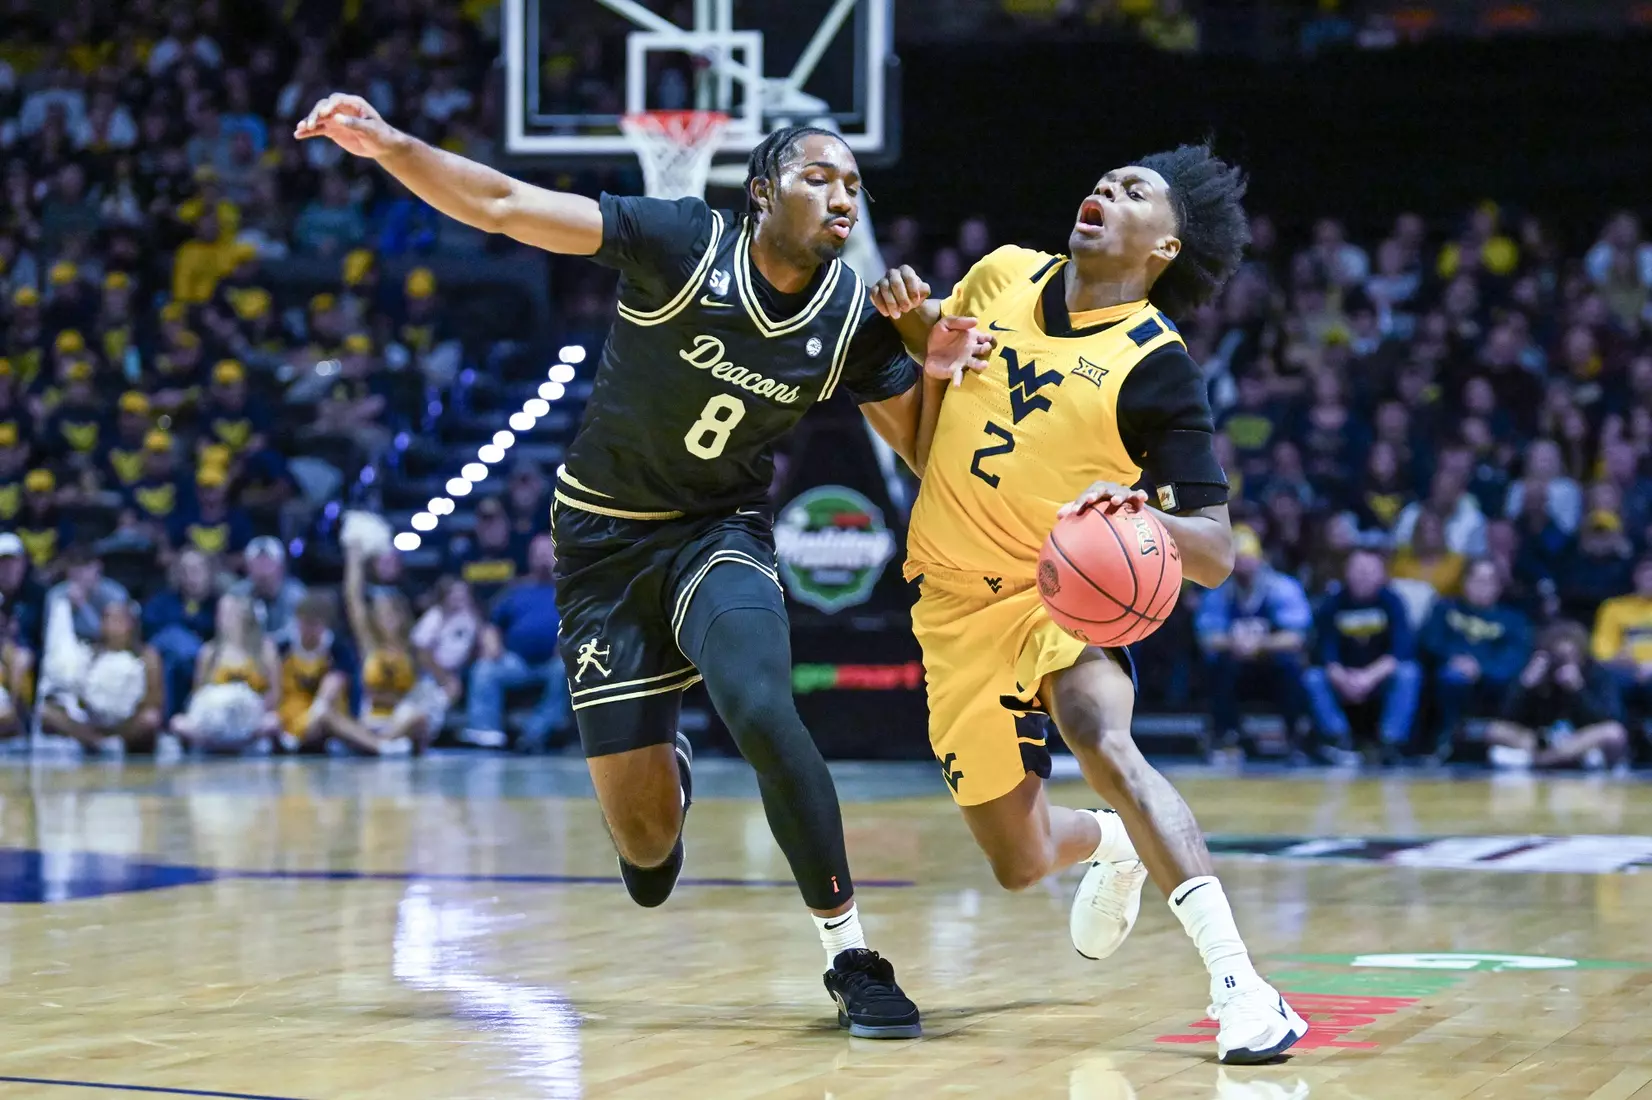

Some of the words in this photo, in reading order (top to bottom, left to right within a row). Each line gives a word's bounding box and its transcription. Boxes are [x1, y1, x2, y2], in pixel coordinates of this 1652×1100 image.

[680, 335, 800, 404] Deacons
[684, 393, 746, 460] 8
[970, 420, 1016, 489] 2
